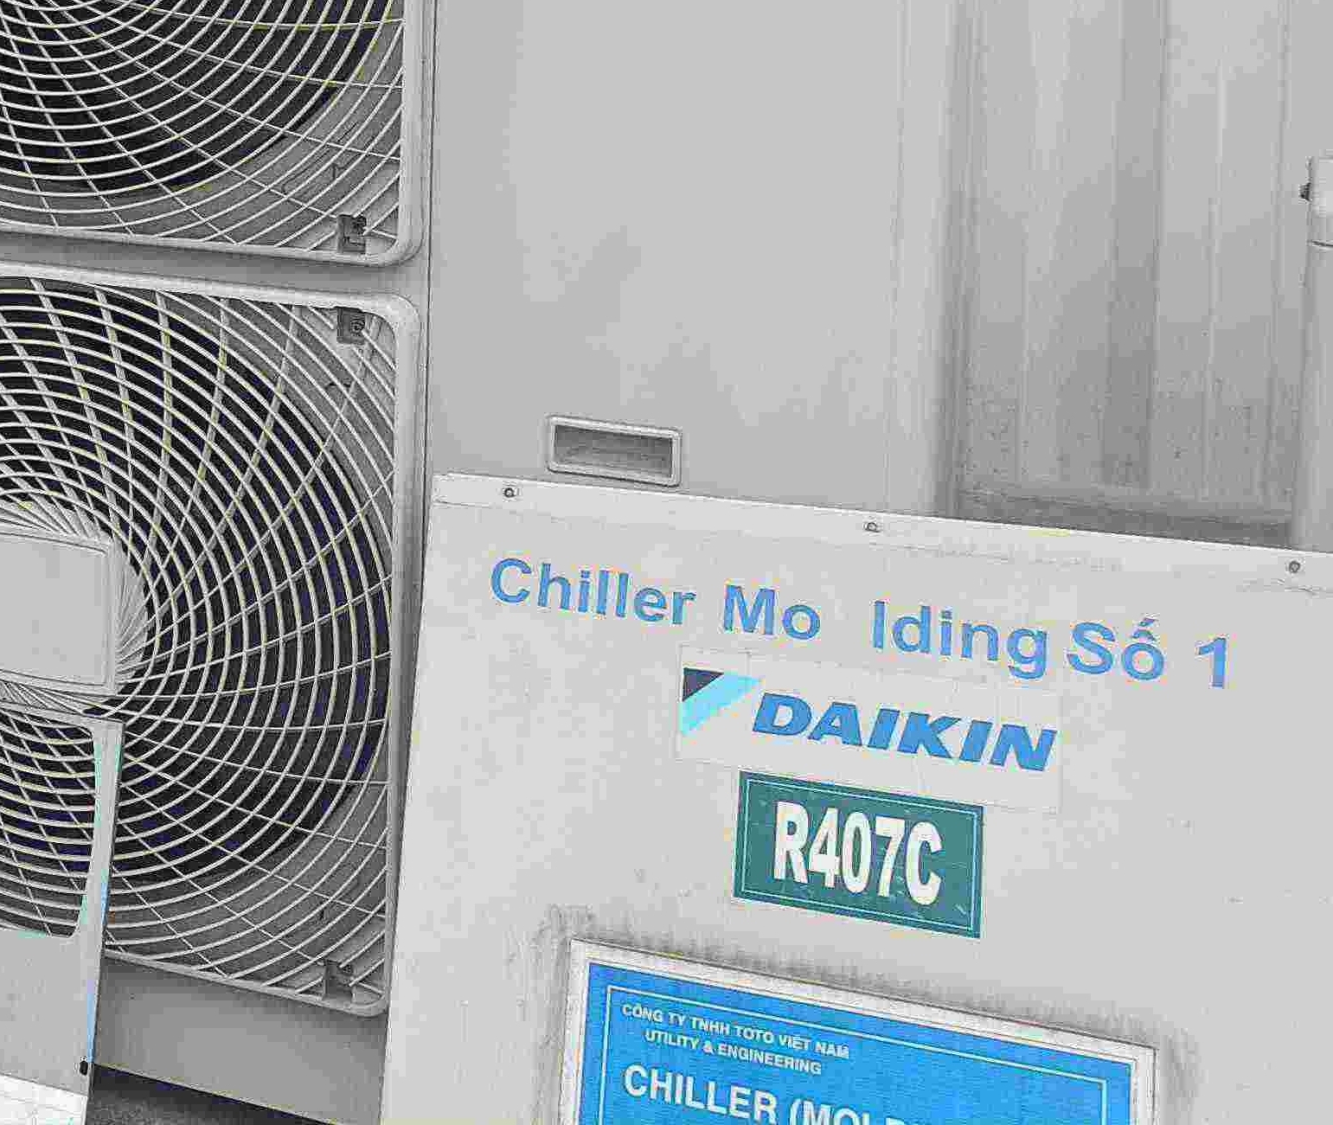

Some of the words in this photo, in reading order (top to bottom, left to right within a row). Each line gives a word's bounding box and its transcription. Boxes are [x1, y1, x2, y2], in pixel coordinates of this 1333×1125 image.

[490, 557, 697, 626] Chiller
[1066, 617, 1165, 681] Số
[1196, 636, 1228, 689] 1
[752, 692, 1058, 772] DAIKIN
[773, 800, 943, 906] R407C
[622, 1002, 664, 1023] CÔNG
[668, 1011, 686, 1026] TY
[689, 1016, 730, 1035] TNHH
[733, 1025, 775, 1044] TOTO
[778, 1033, 812, 1052] VIỆT
[815, 1041, 850, 1059] NAM
[644, 1028, 700, 1050] UTILITY
[702, 1040, 715, 1055] &
[717, 1042, 822, 1075] ENGINEERING
[623, 1064, 779, 1125] CHILLER
